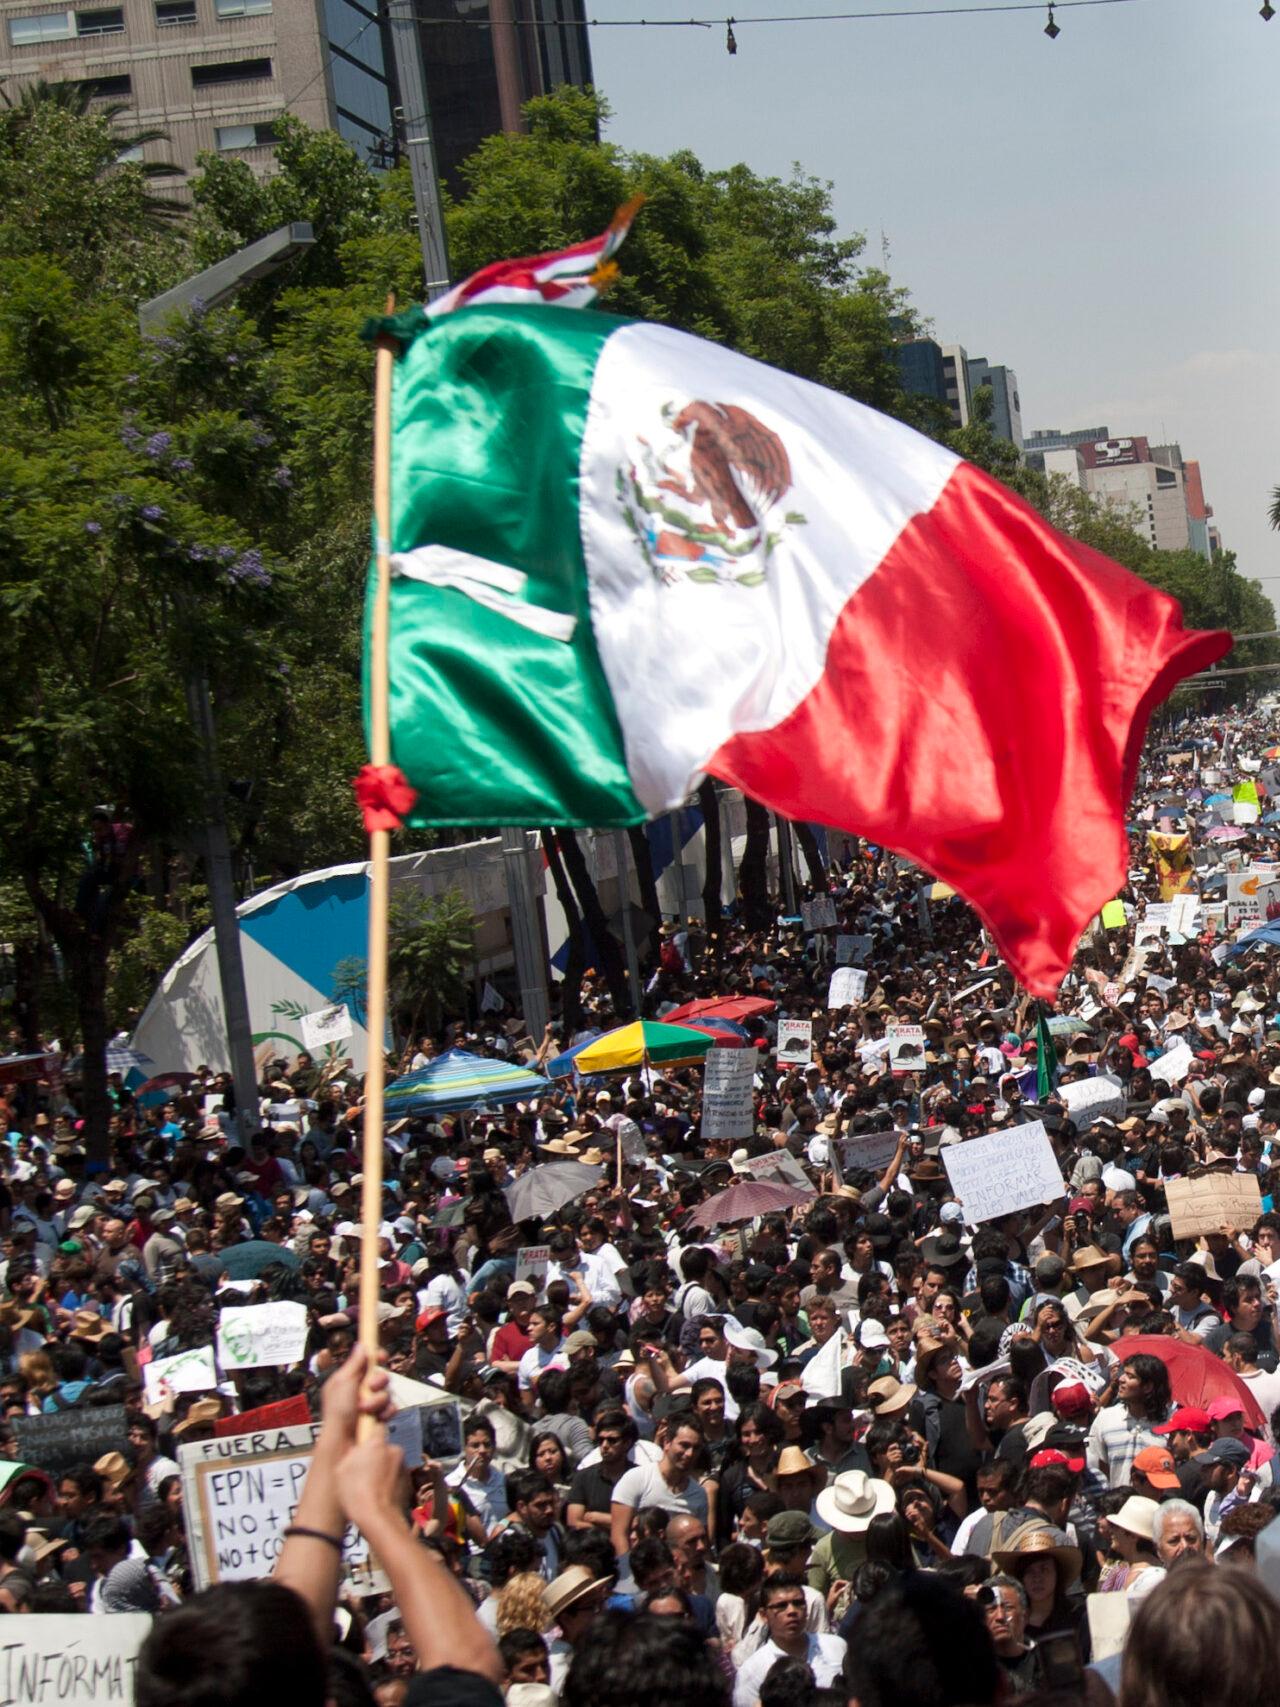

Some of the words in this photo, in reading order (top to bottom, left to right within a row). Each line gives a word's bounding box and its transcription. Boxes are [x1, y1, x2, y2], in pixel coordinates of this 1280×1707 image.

[966, 1170, 1048, 1207] INFORMAR
[201, 1432, 296, 1459] FUERA
[211, 1468, 265, 1506] EPN
[217, 1514, 259, 1541] NO
